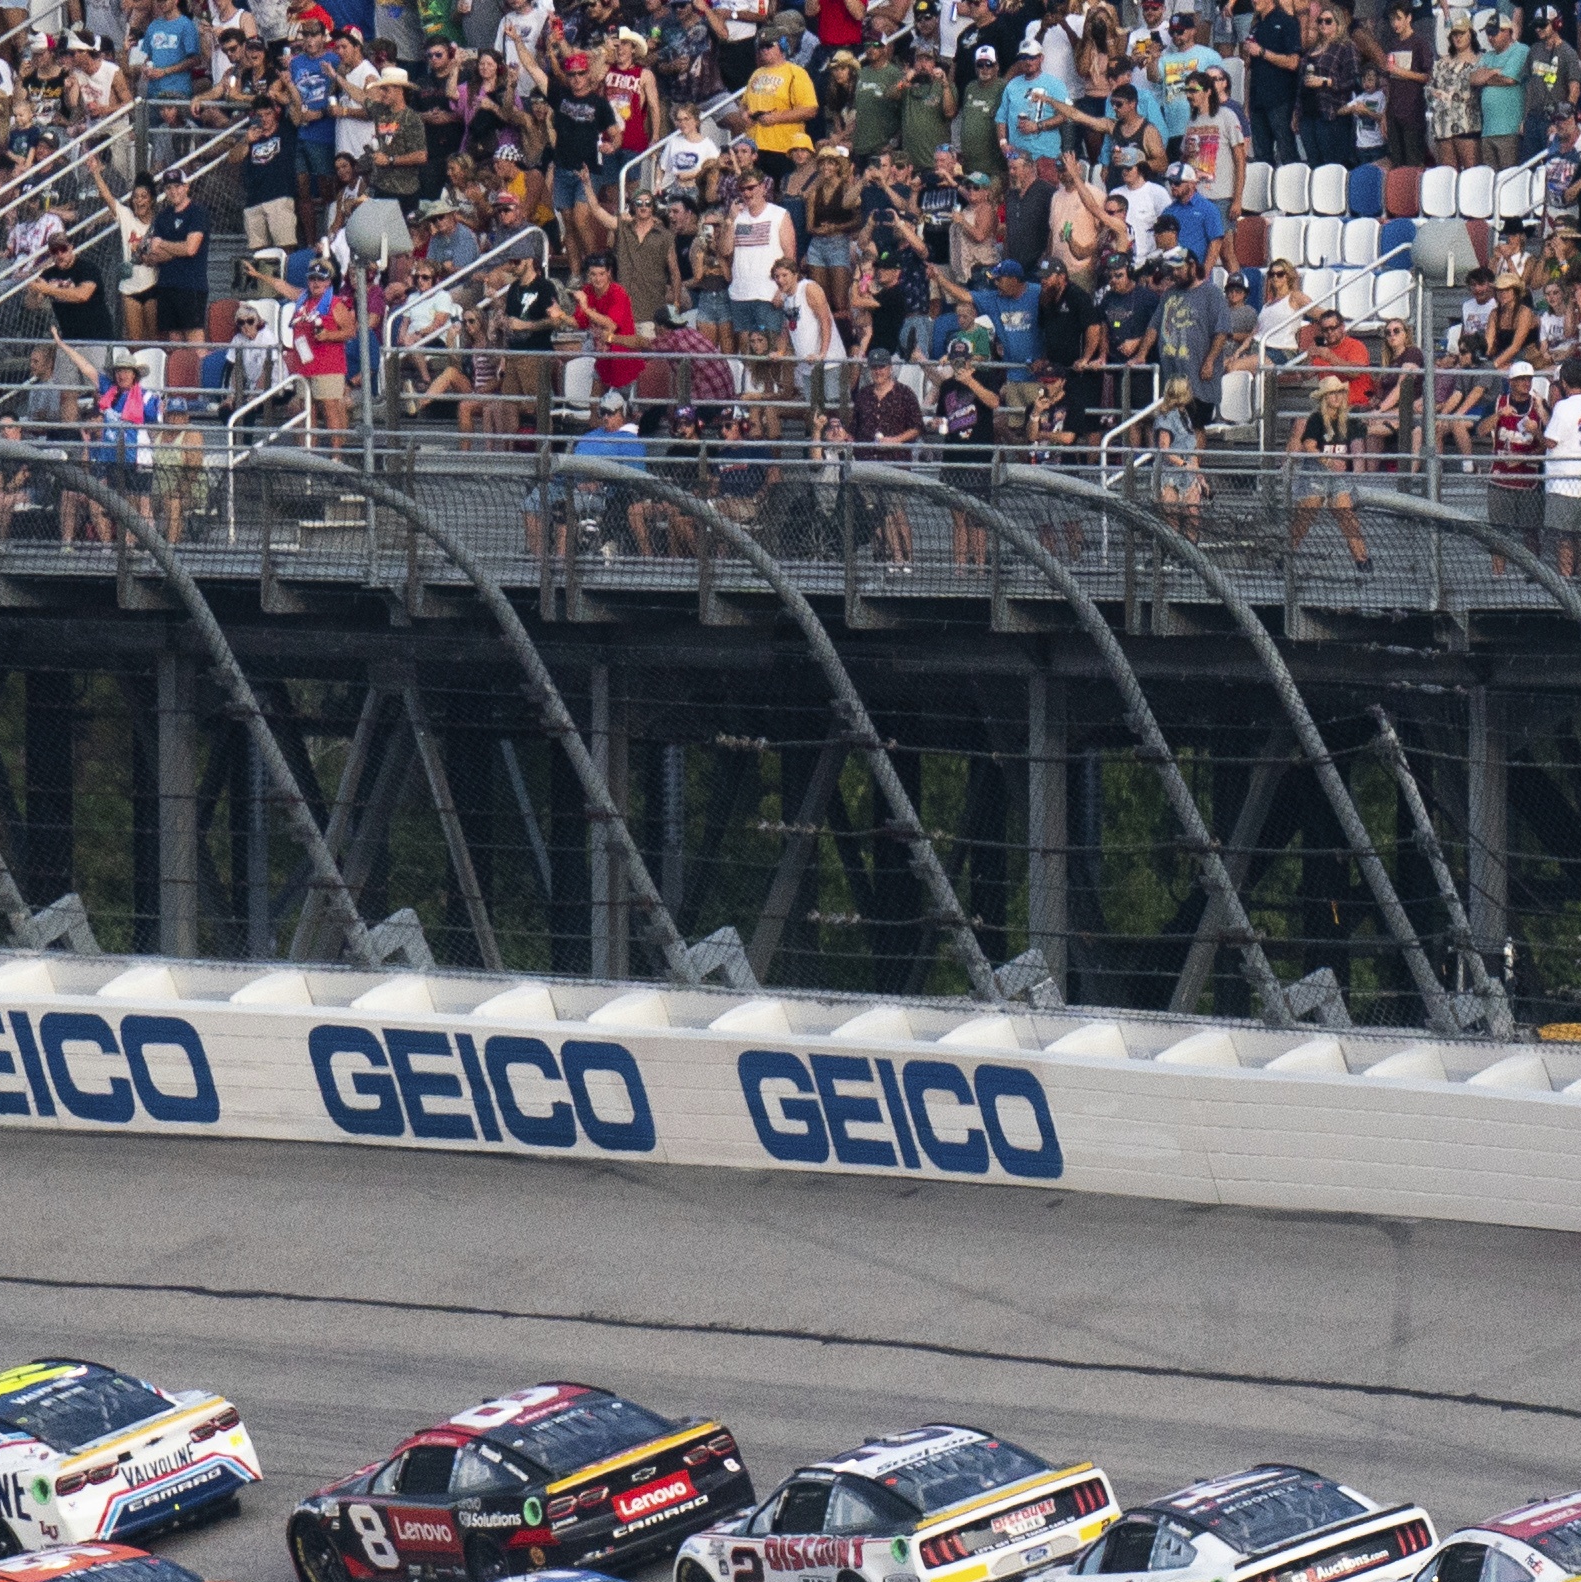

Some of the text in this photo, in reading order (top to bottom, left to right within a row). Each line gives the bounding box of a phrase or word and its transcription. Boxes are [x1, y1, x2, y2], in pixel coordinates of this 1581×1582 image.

[308, 1024, 657, 1153] GEICO
[738, 1049, 1064, 1179] GEICO
[120, 1442, 195, 1490] VALVOLINE
[723, 1457, 741, 1472] 8
[612, 1495, 709, 1539] CAMARO
[618, 1479, 688, 1518] Lenovo
[991, 1498, 1055, 1533] DISCOUNT
[348, 1504, 400, 1569] 8
[392, 1512, 452, 1545] Lenovo
[471, 1510, 522, 1529] Solutions
[764, 1535, 867, 1571] DISCOUNT
